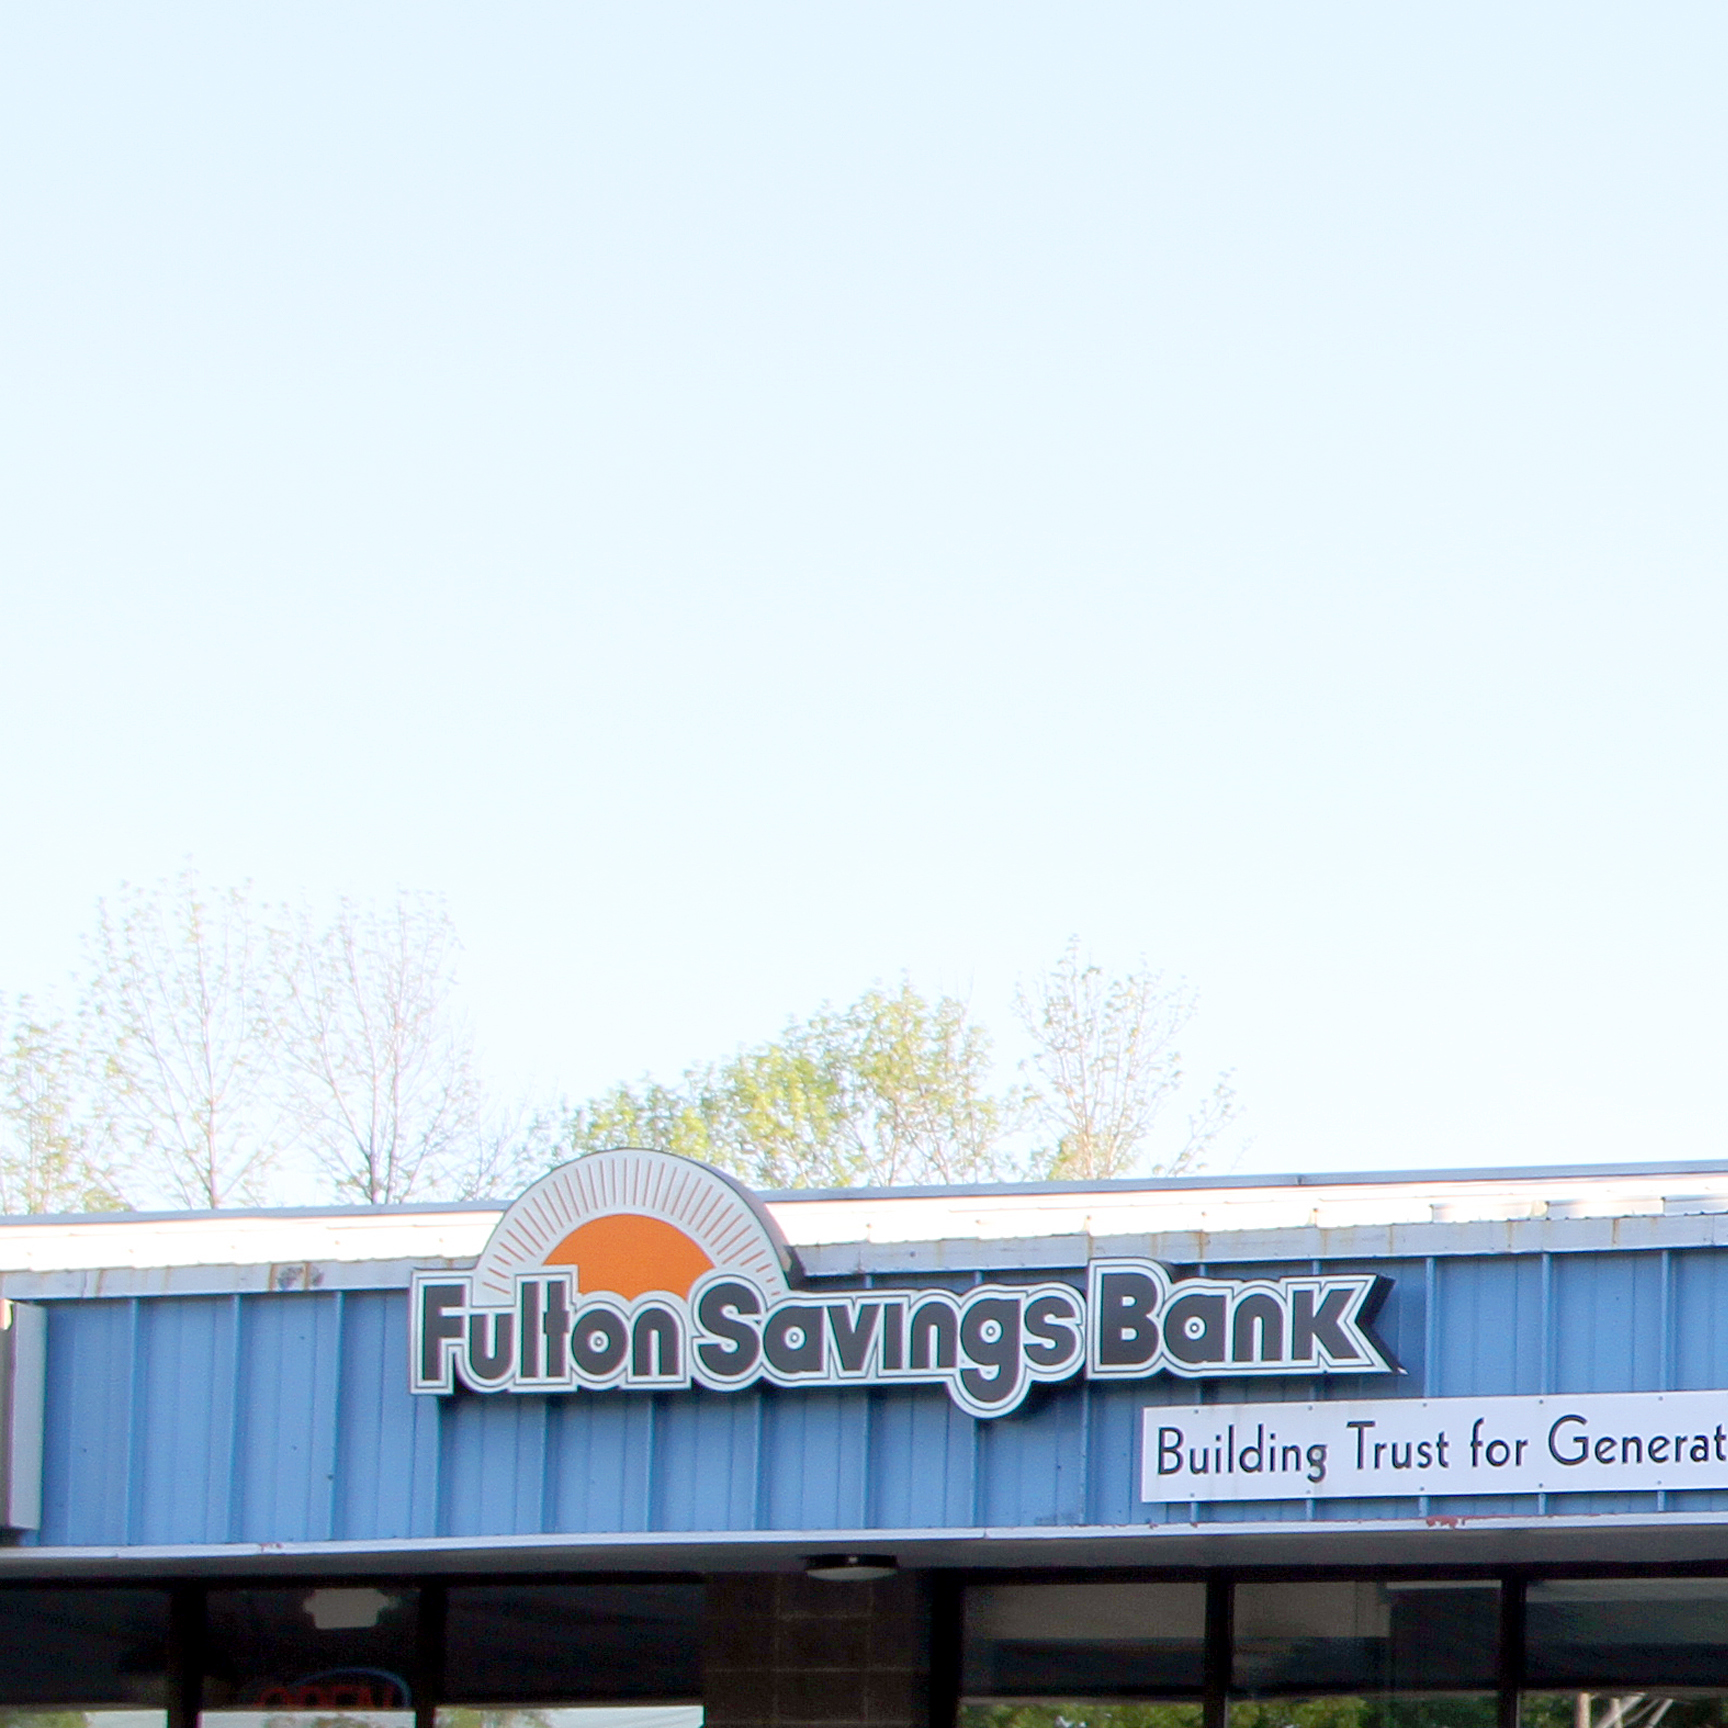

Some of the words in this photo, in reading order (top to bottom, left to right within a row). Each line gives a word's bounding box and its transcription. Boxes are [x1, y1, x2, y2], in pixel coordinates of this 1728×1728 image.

[421, 1280, 681, 1382] Fulton
[699, 1282, 1077, 1403] Savings
[1100, 1273, 1363, 1366] Bank
[1157, 1424, 1328, 1483] Building
[1346, 1419, 1450, 1470] Trust
[1470, 1417, 1529, 1468] for
